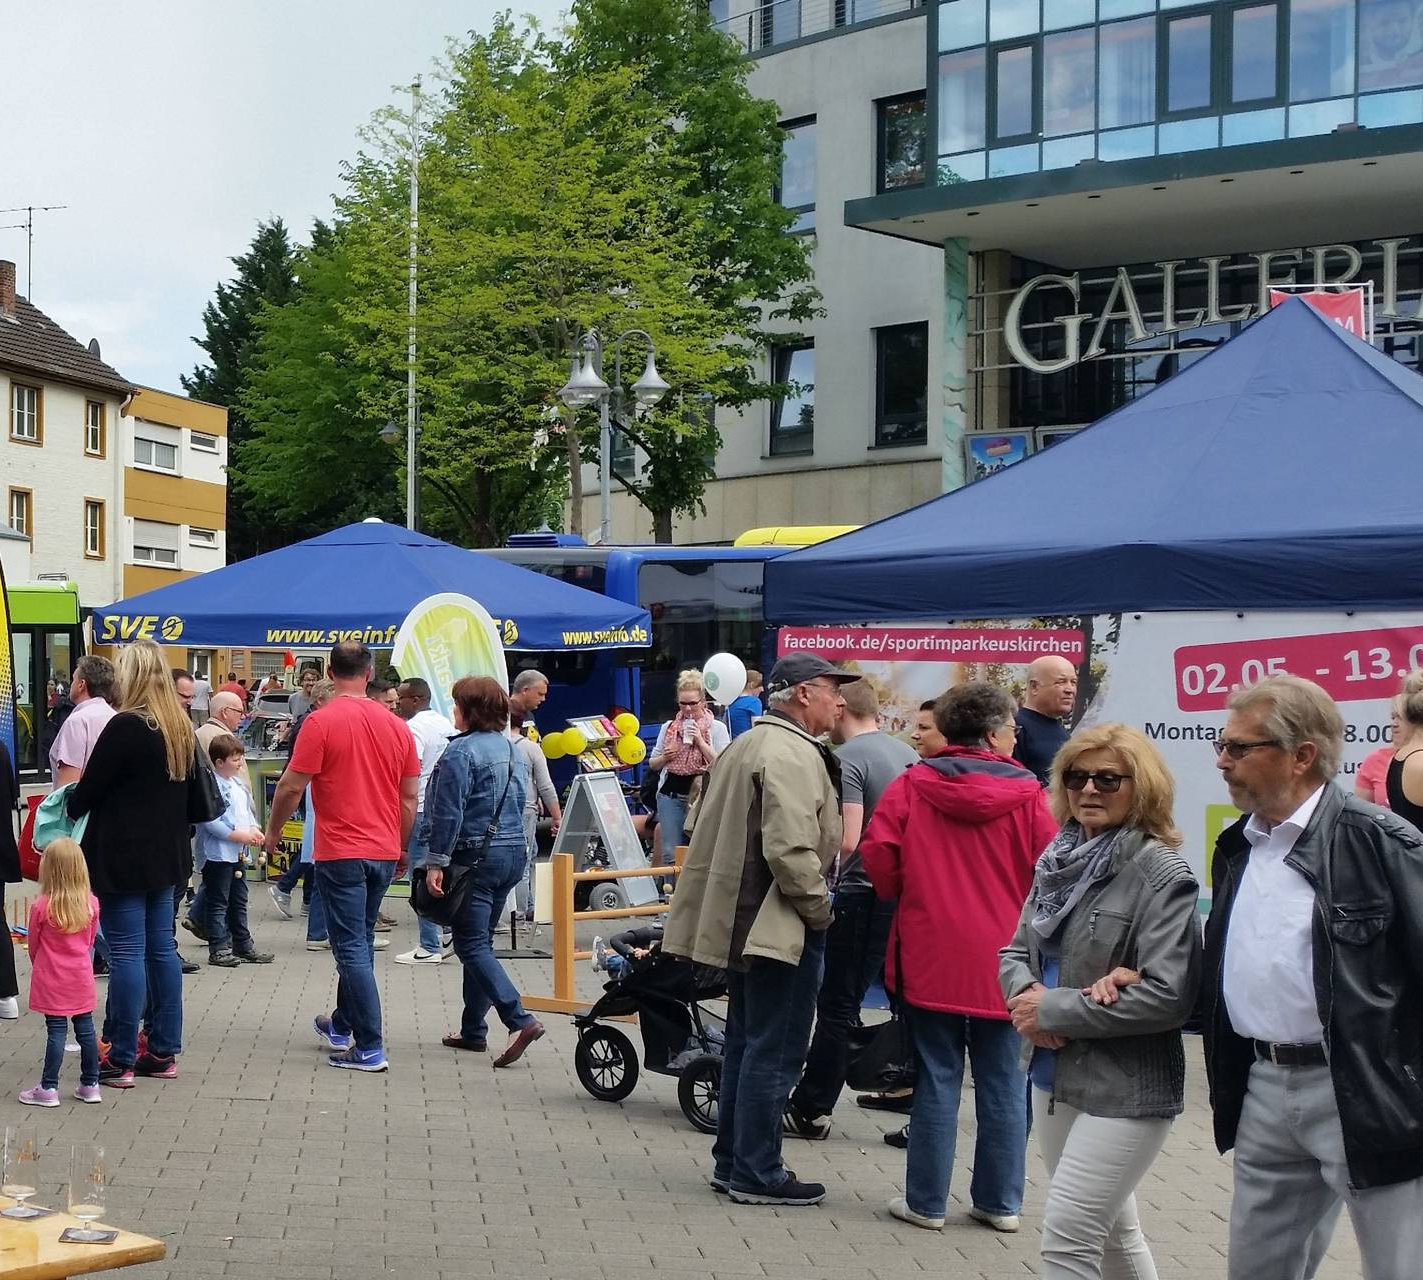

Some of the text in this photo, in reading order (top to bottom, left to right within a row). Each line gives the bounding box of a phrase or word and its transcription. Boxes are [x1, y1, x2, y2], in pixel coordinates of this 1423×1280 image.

[1004, 238, 1423, 375] GALLERI
[102, 615, 159, 640] SVE
[783, 633, 1082, 654] facebook.de/sportimparkeuskirchen
[1145, 722, 1225, 742] Monta
